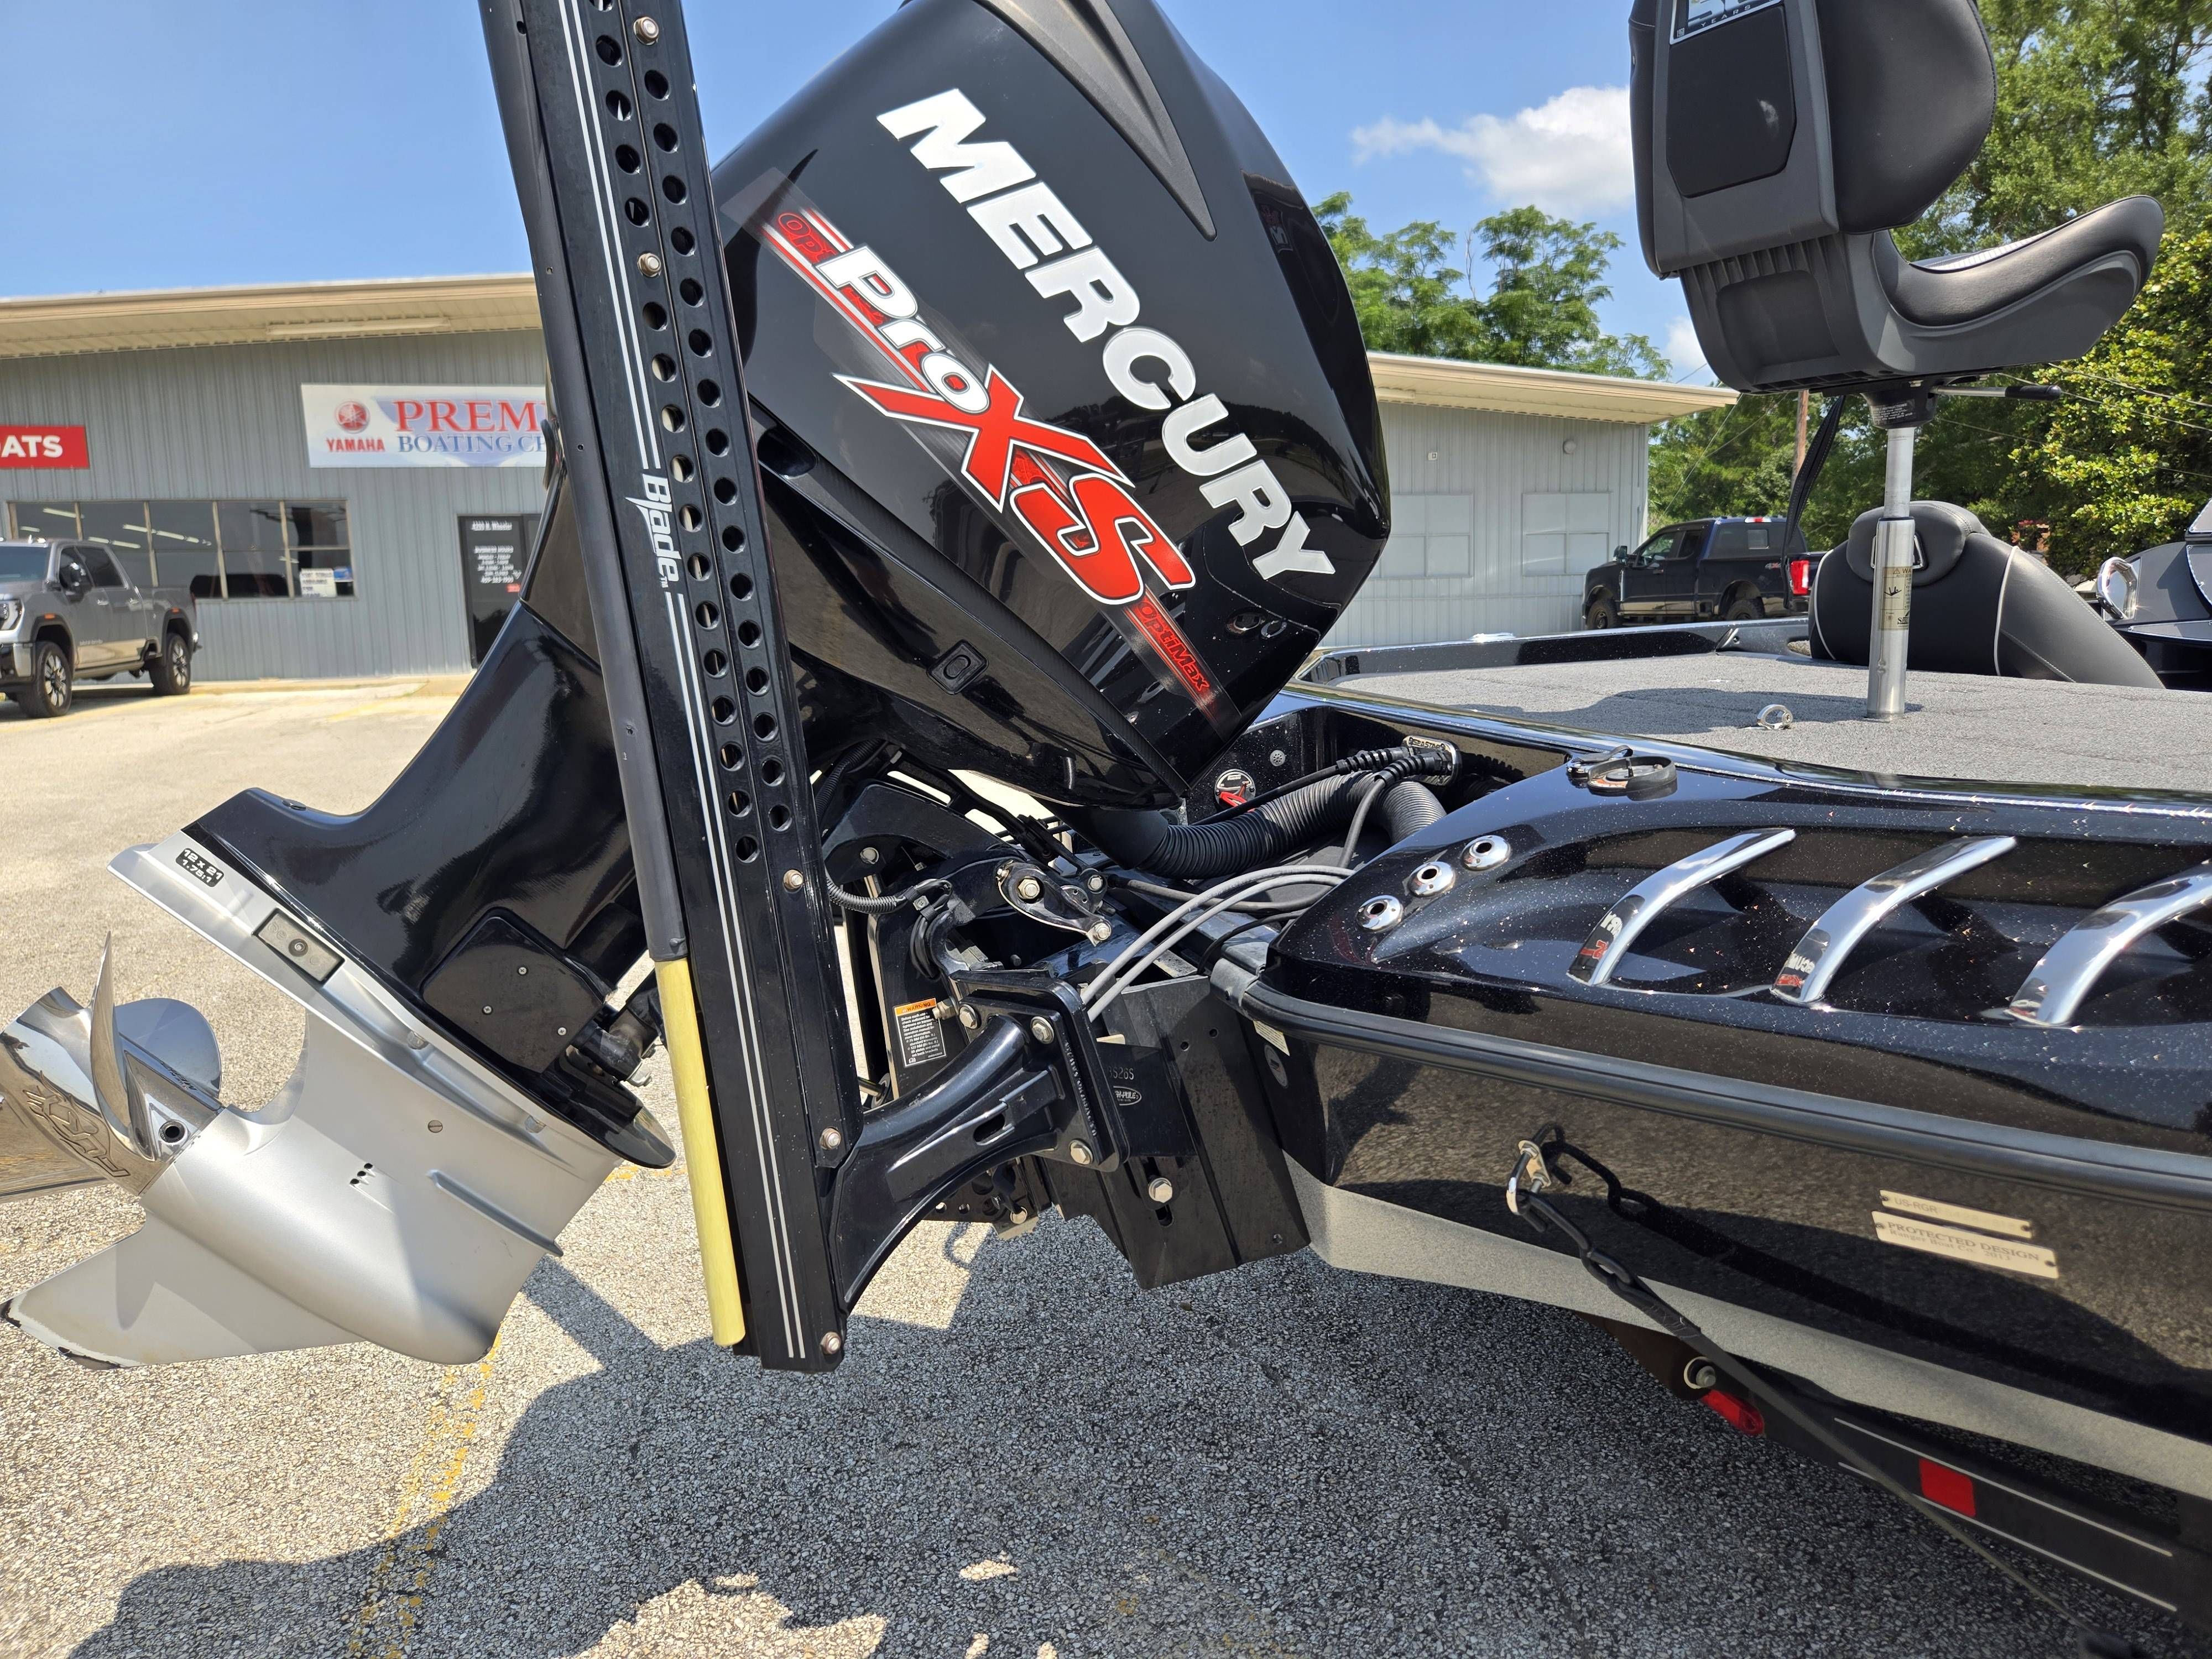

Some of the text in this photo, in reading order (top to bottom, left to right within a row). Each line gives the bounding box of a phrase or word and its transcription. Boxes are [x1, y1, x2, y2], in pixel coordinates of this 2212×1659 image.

[1700, 4, 1751, 28] YEARS
[813, 245, 990, 414] Pro
[876, 88, 1335, 580] MERCURY
[393, 401, 546, 432] PREM
[0, 435, 63, 458] ATS
[326, 438, 385, 452] YAMAHA
[398, 435, 513, 453] BOATING
[625, 473, 682, 582] Blade
[184, 849, 199, 863] 12
[206, 866, 223, 880] 21
[1894, 1197, 1938, 1214] US-RGR
[1887, 1221, 2039, 1261] PROTECTED DESIGN
